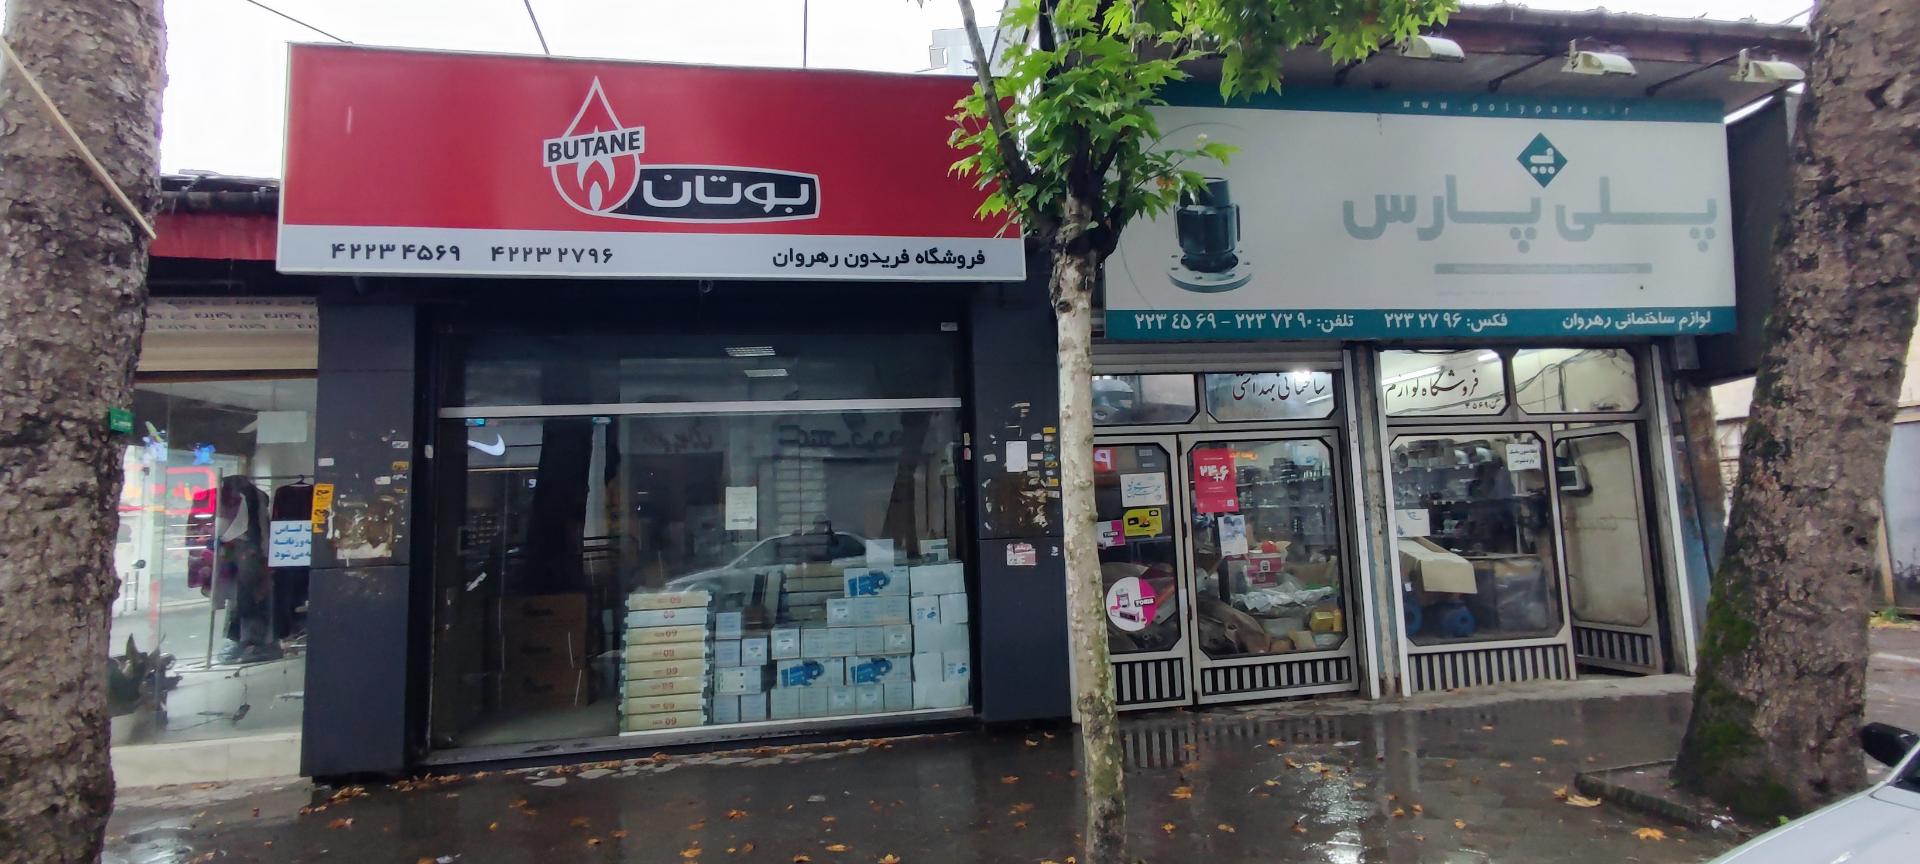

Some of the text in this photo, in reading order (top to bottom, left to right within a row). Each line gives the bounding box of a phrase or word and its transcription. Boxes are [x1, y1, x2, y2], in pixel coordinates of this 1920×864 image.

[547, 130, 641, 162] BUTANE
[643, 174, 810, 213] بوتان
[1342, 174, 1718, 254] پلی پارس
[332, 243, 460, 262] ۴۲۲۳ ۴۵۶۹
[491, 245, 613, 264] ۴۲۲۳ ۲۷۹۶
[772, 247, 986, 269] فروشگاه فریدون رهروان
[1134, 313, 1167, 330] ۲۲۳
[1196, 312, 1217, 330] ۶۹
[1235, 313, 1267, 329] ۲۲۳
[1271, 313, 1293, 329] ۷۲
[1297, 312, 1312, 328] ۹۰
[1316, 314, 1354, 333] تلفن:
[1384, 312, 1508, 332] فکس: ۲۲۳ ۲۷ ۹۶
[1562, 311, 1712, 330] لوازم ساختمانی رهروان
[1385, 365, 1479, 410] فروشگاه لوازم
